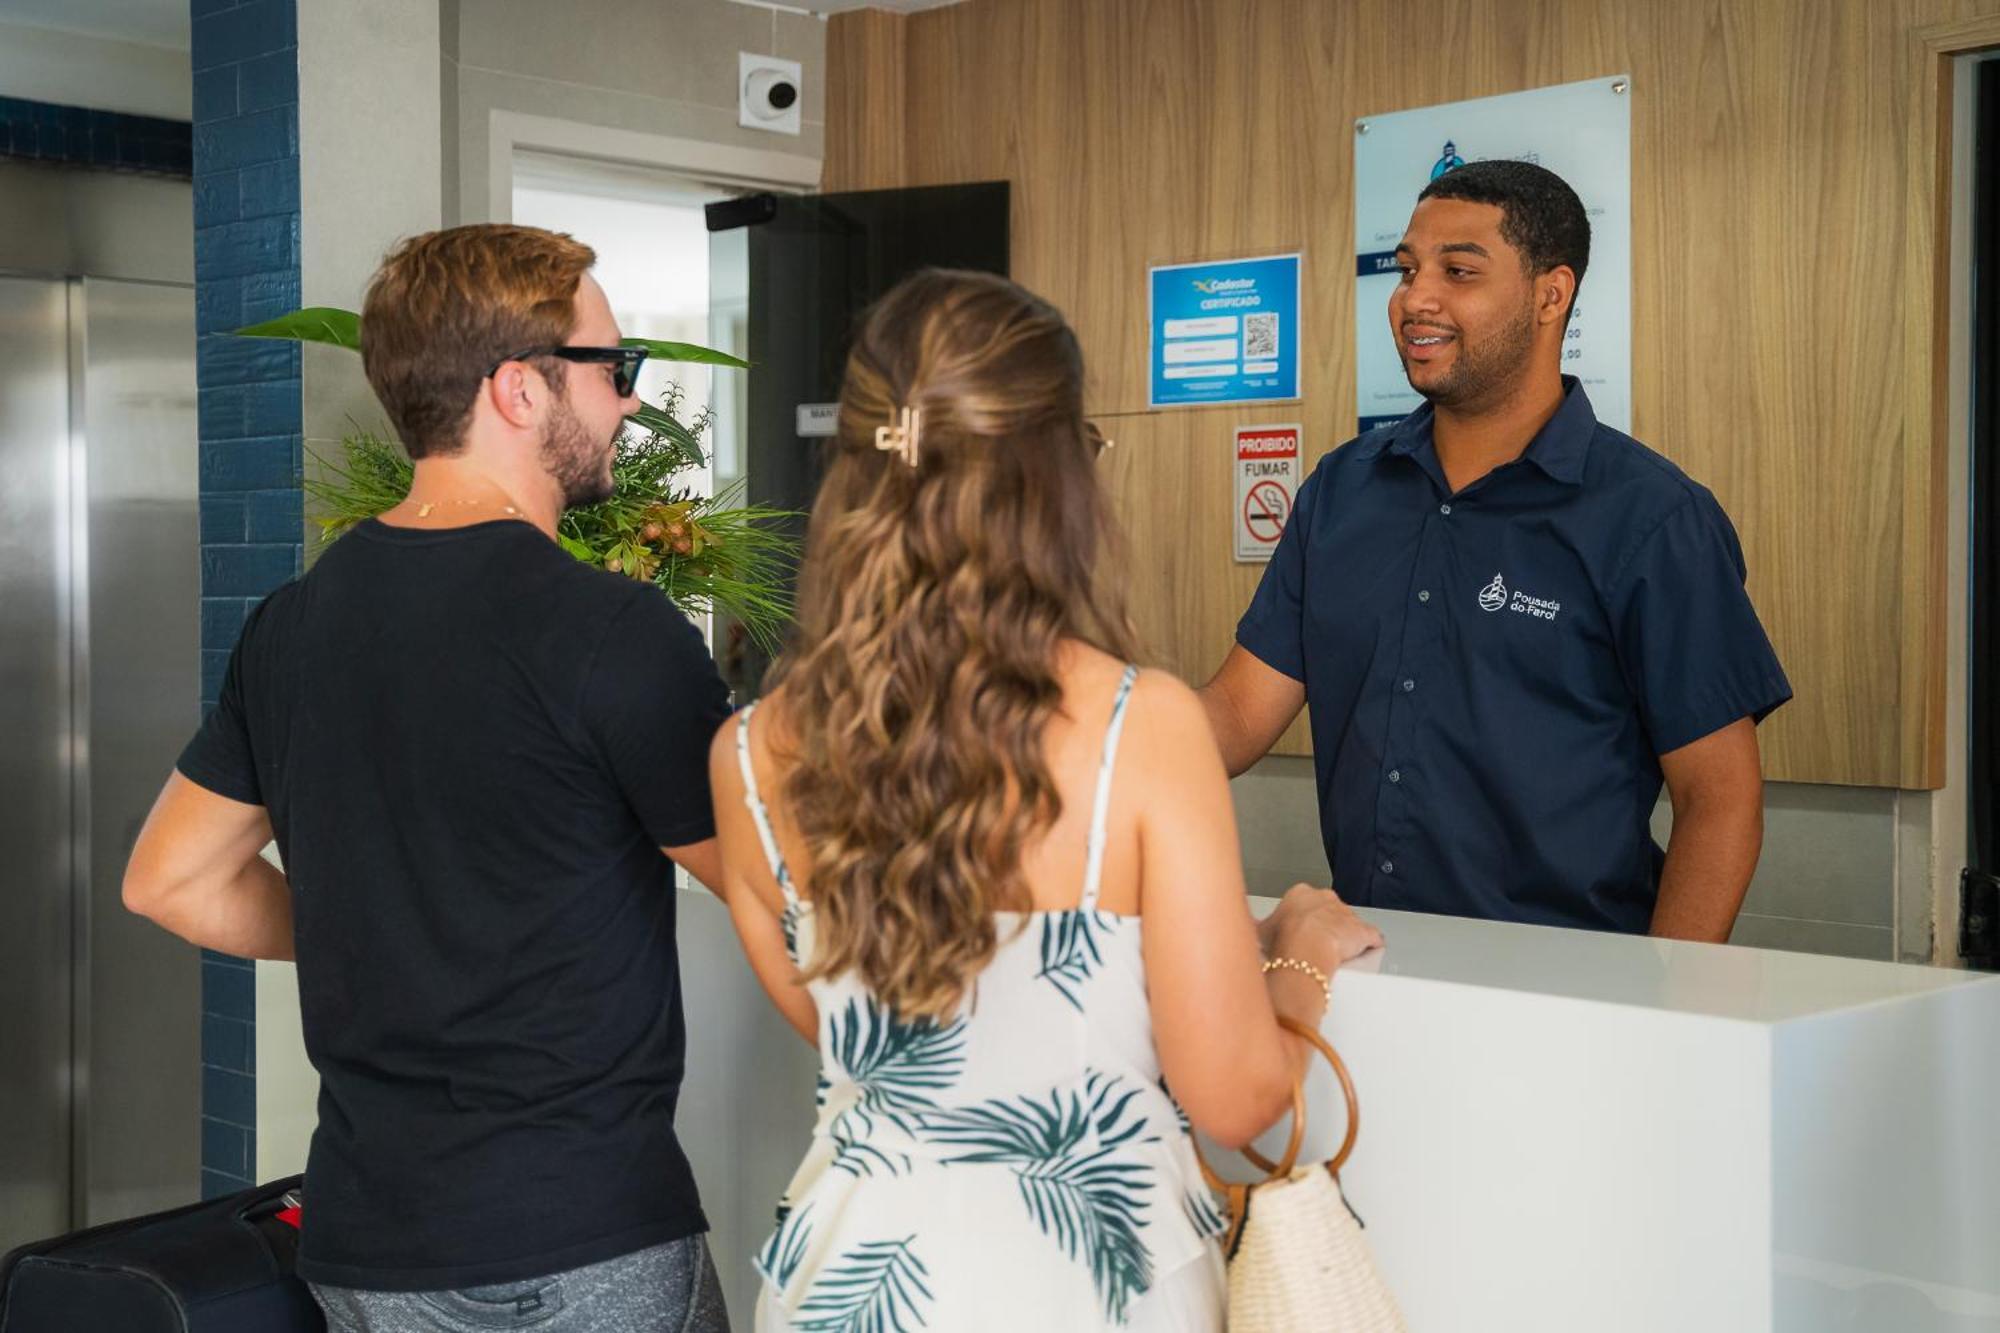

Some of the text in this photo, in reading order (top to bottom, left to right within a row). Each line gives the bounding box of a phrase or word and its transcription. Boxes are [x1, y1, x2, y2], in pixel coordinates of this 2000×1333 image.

[1376, 257, 1398, 270] TAR
[1239, 437, 1296, 453] PROIBIDO
[1245, 461, 1290, 477] FUMAR
[1513, 591, 1560, 611] Pousada
[1510, 601, 1556, 621] do Farol
